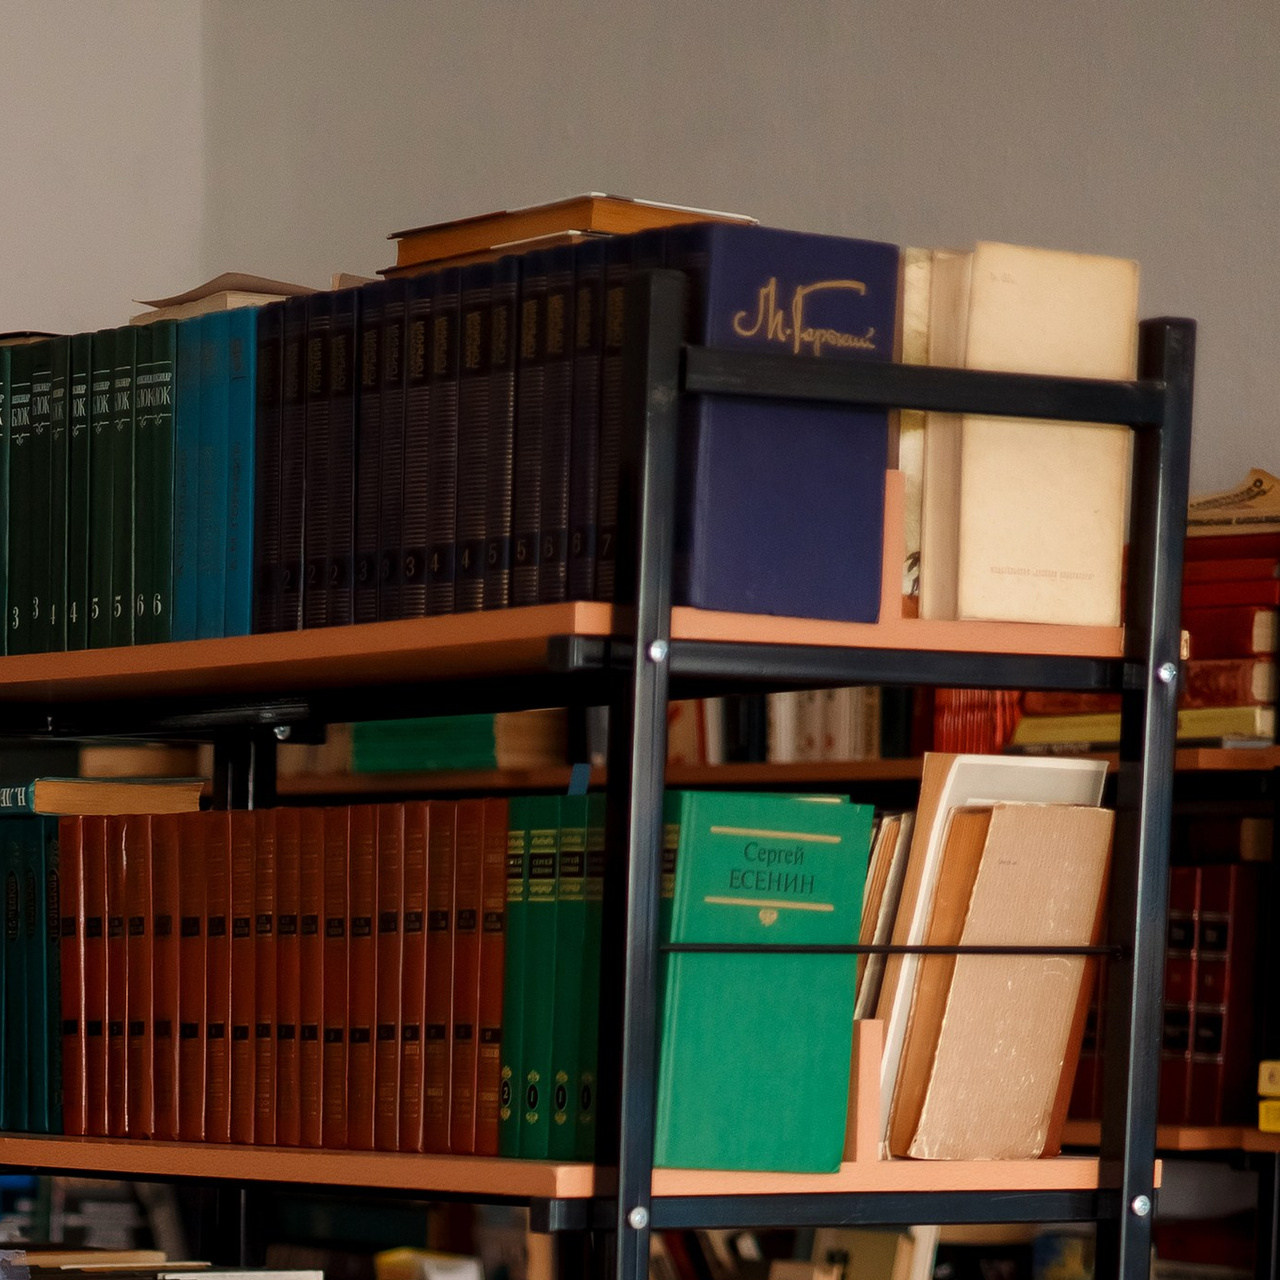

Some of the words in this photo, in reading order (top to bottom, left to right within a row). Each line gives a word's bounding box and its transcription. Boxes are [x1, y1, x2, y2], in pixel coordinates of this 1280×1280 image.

[33, 597, 39, 619] 3
[71, 602, 77, 622] 4
[92, 598, 98, 619] 5
[114, 596, 121, 617] 5
[137, 594, 144, 617] 6
[153, 593, 161, 615] 6
[13, 607, 19, 629] 3
[15, 787, 25, 805] Н.
[744, 841, 804, 867] Сергей
[729, 869, 814, 895] ЕСЕНИН
